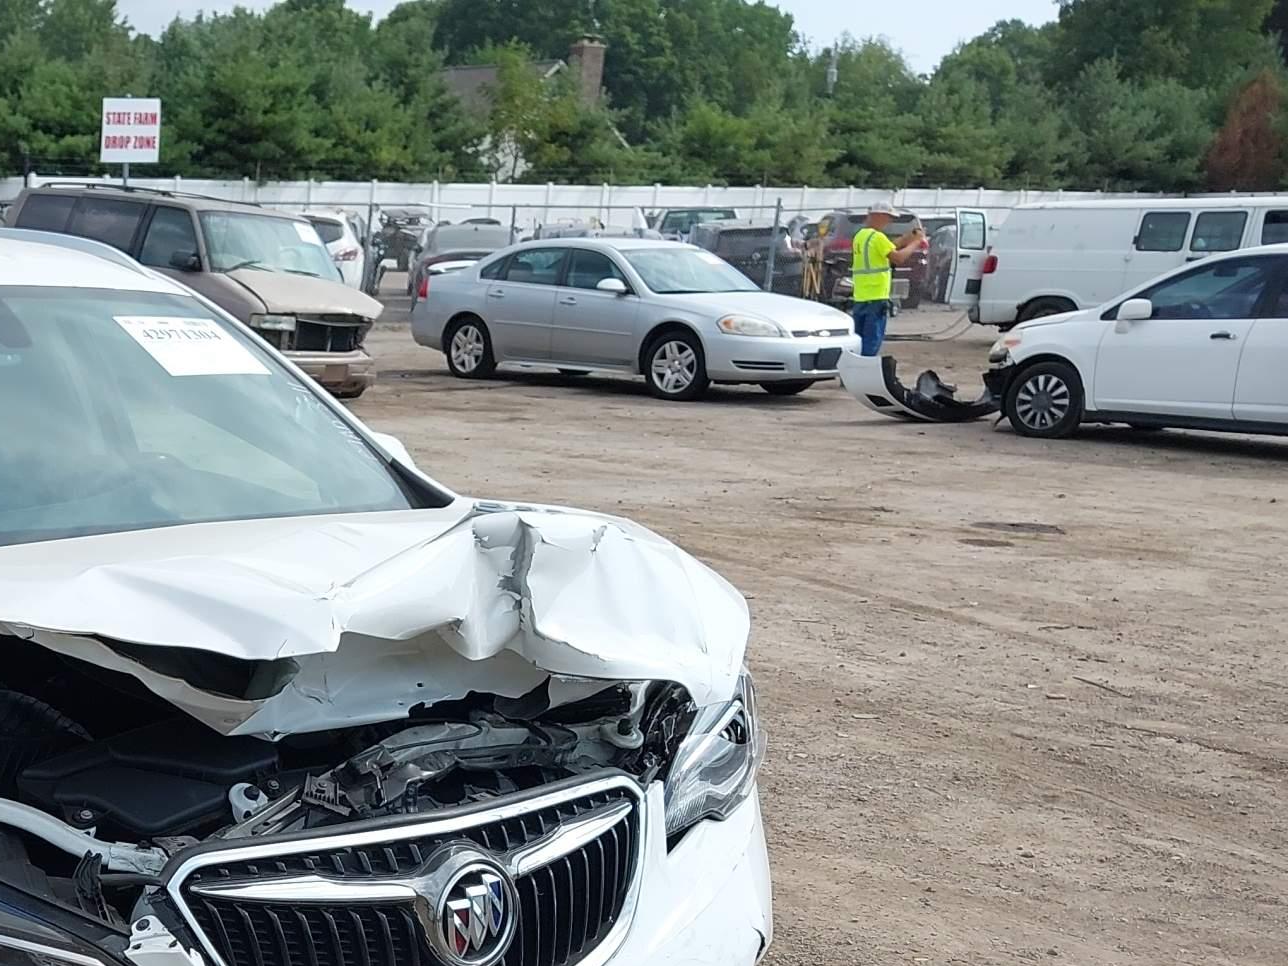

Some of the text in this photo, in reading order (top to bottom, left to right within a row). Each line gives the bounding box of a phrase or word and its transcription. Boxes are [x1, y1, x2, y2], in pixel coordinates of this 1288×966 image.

[106, 112, 157, 125] STATE FARM
[104, 136, 156, 149] DROP ZONE
[142, 328, 222, 341] 42971304
